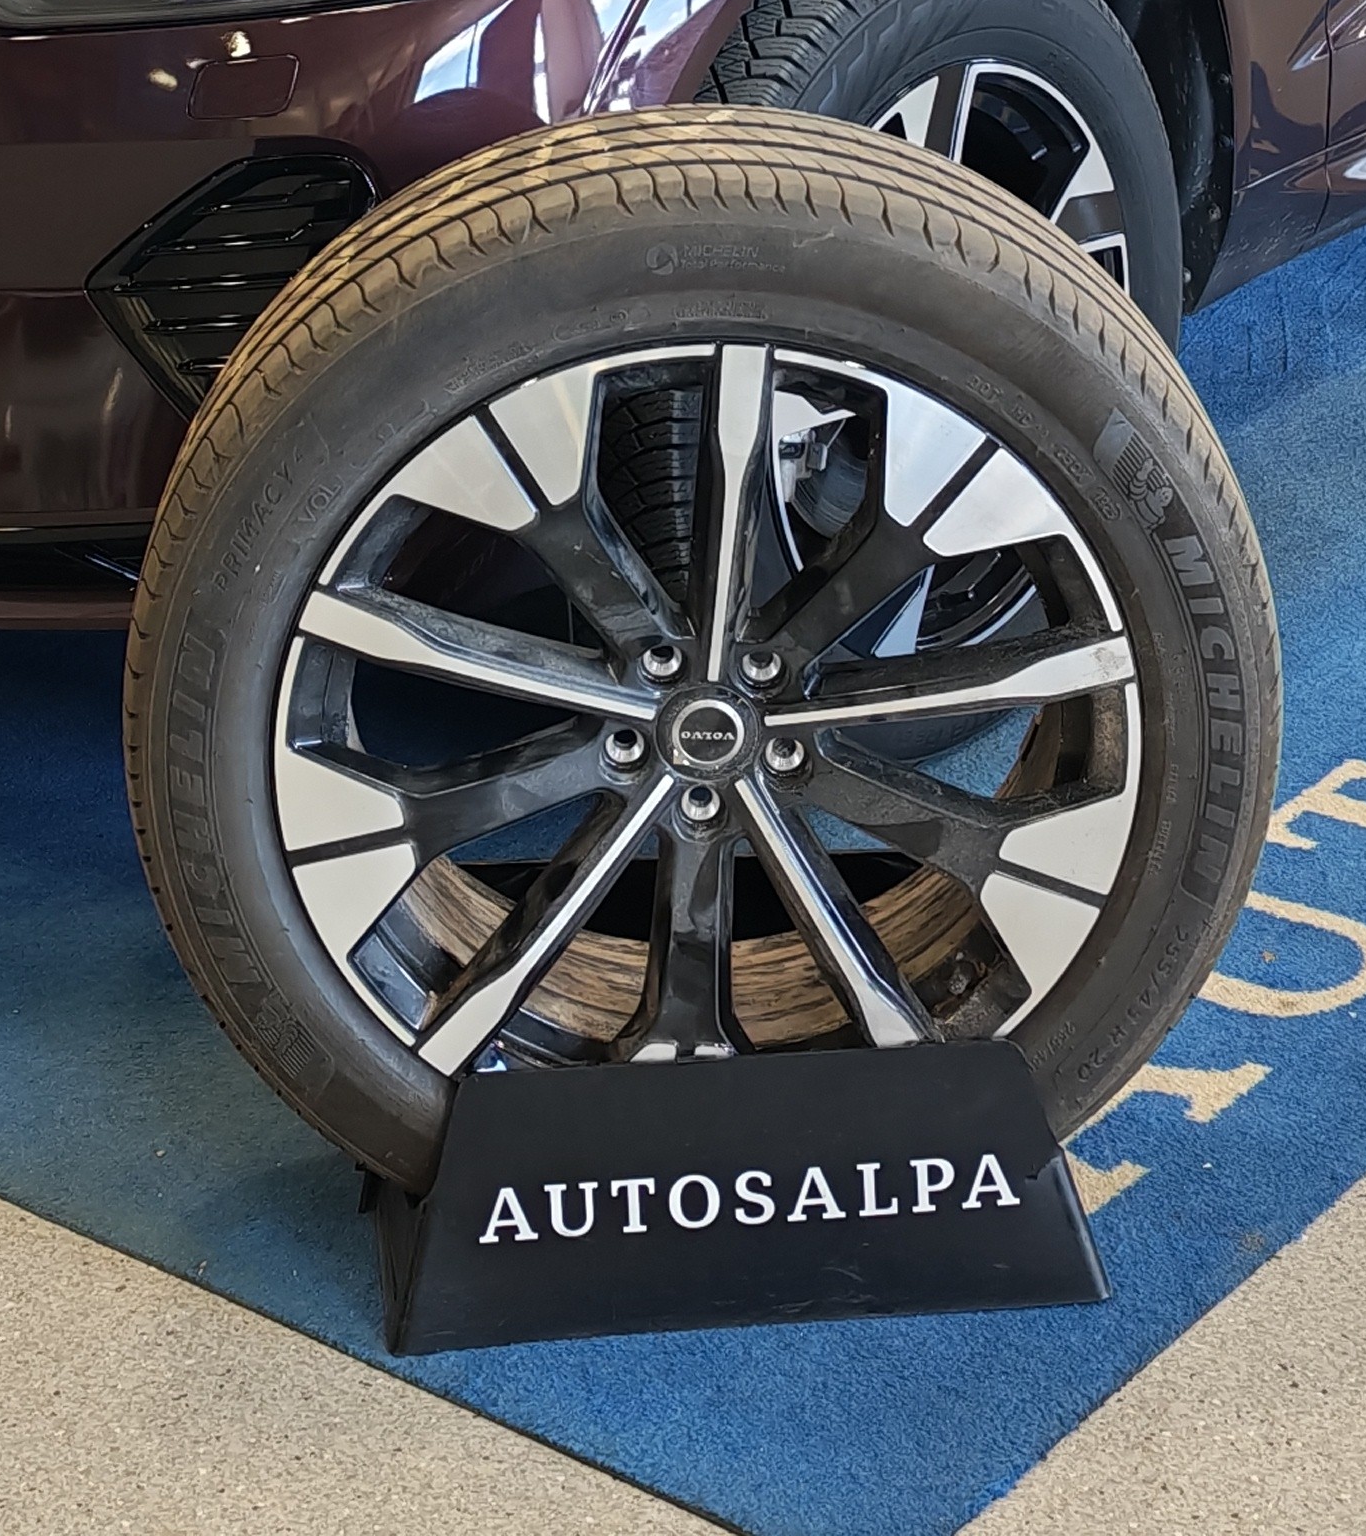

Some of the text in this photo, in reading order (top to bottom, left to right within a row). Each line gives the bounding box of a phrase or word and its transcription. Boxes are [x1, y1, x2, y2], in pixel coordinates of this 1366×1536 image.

[683, 244, 760, 259] MICHELIN
[212, 461, 294, 593] PRIMACY
[680, 729, 736, 742] VOLVO
[1164, 532, 1244, 884] MICHELIN
[169, 632, 263, 985] MICHELIN
[478, 1152, 1022, 1245] AUTOSALPA
